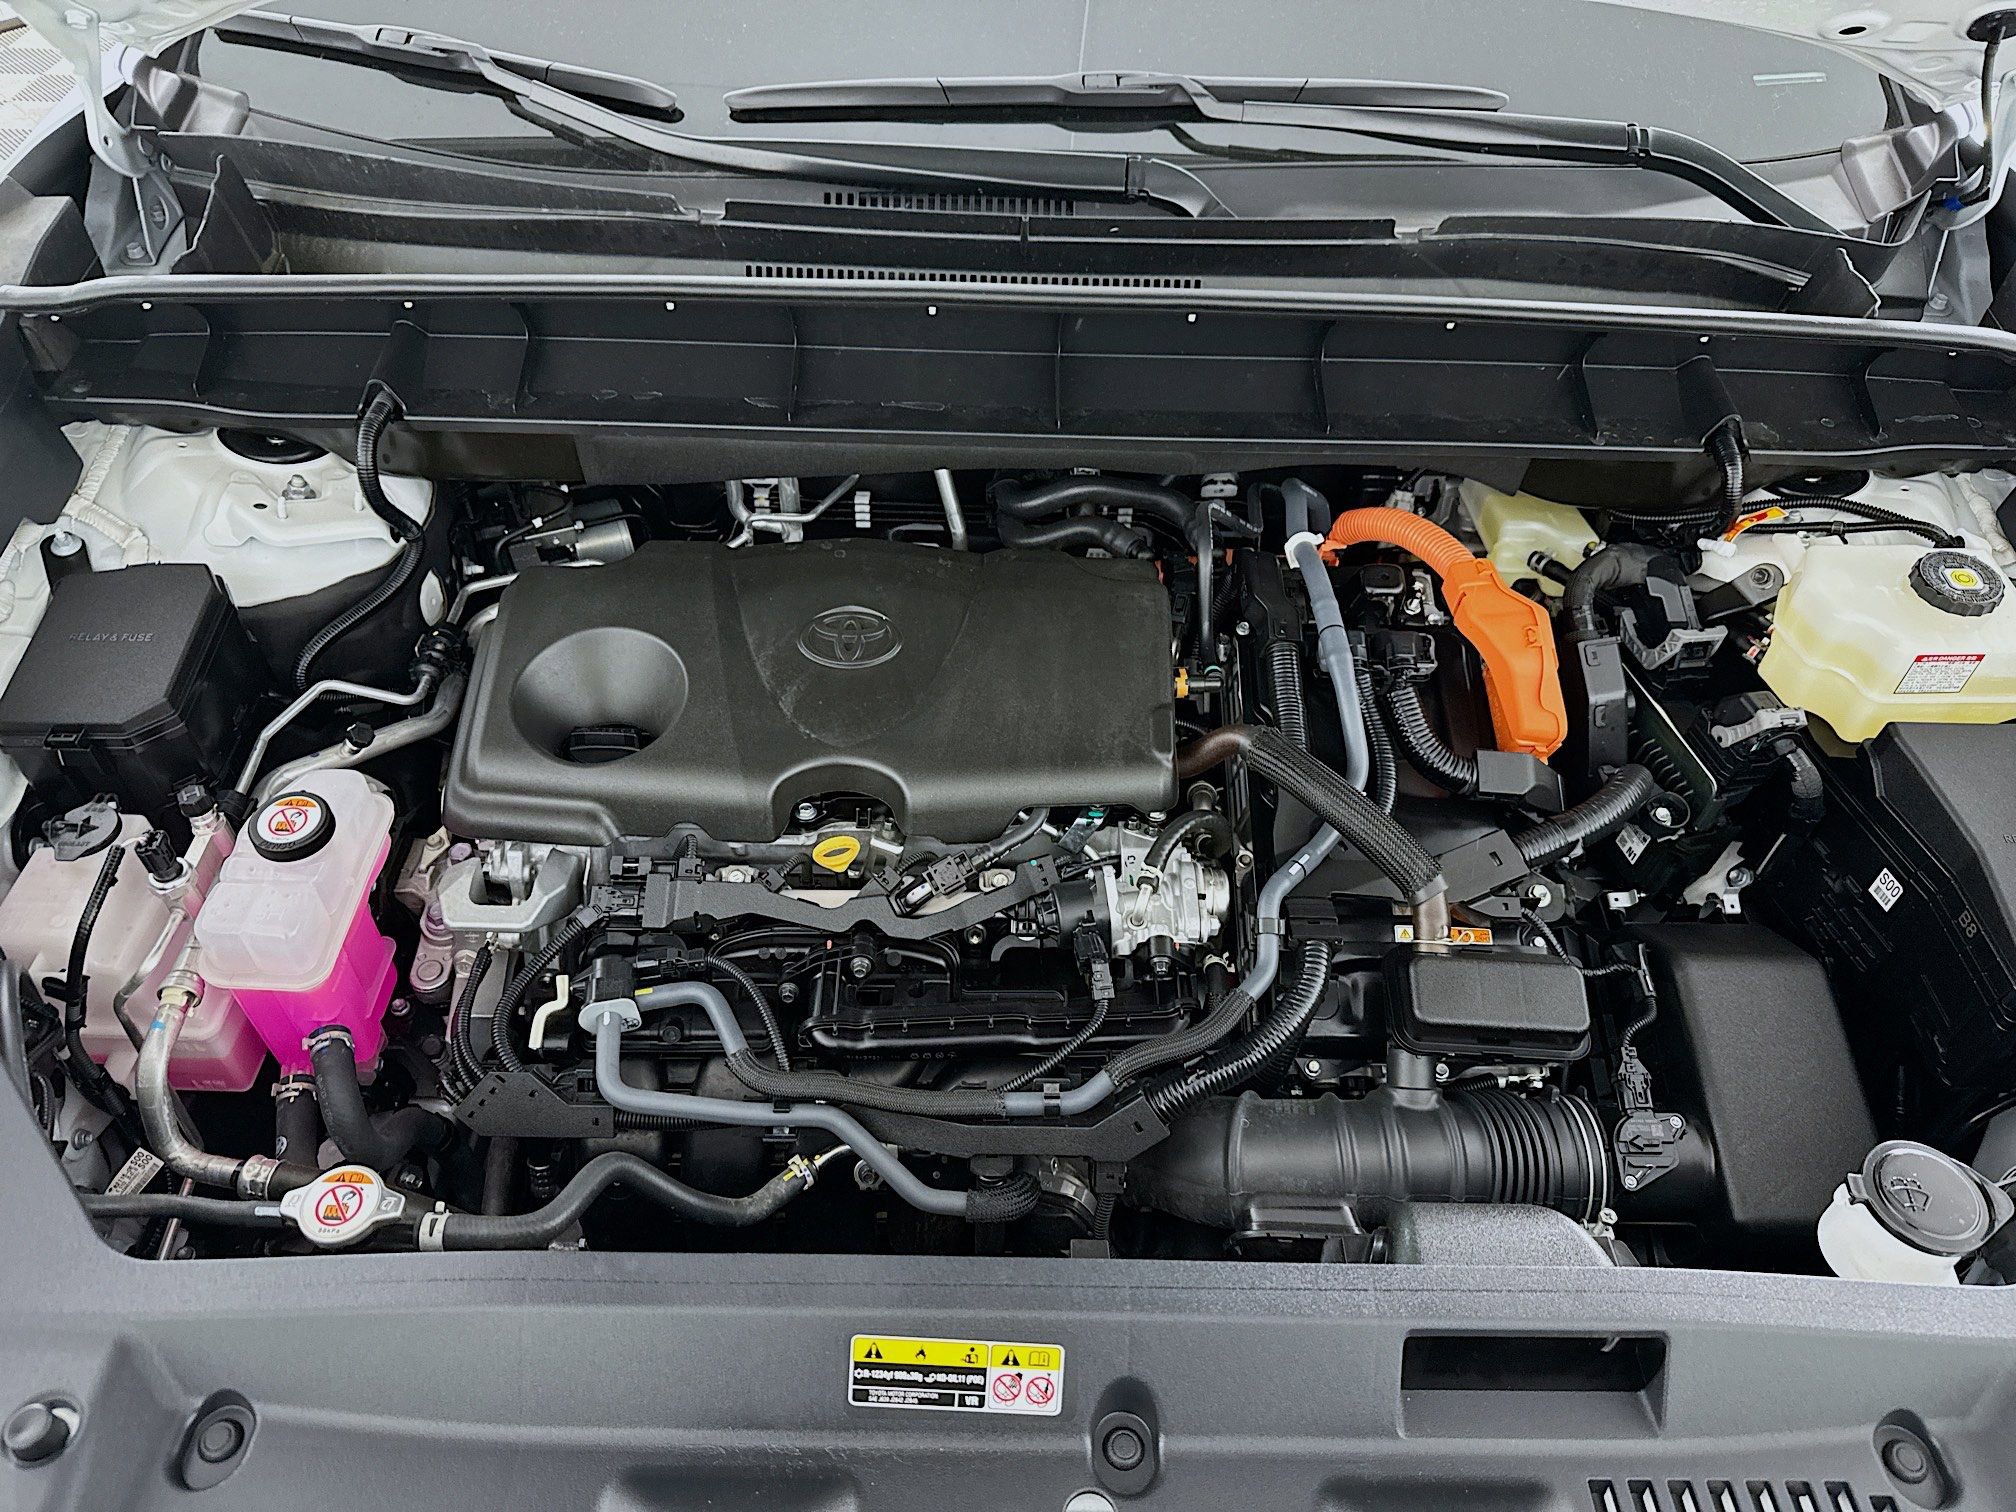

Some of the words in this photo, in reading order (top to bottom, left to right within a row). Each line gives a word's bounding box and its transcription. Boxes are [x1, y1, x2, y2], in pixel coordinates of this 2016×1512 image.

[69, 633, 109, 642] RELAY
[109, 633, 118, 642] &
[121, 633, 153, 642] FUSE
[1625, 846, 1637, 861] N1
[965, 1396, 980, 1406] VR
